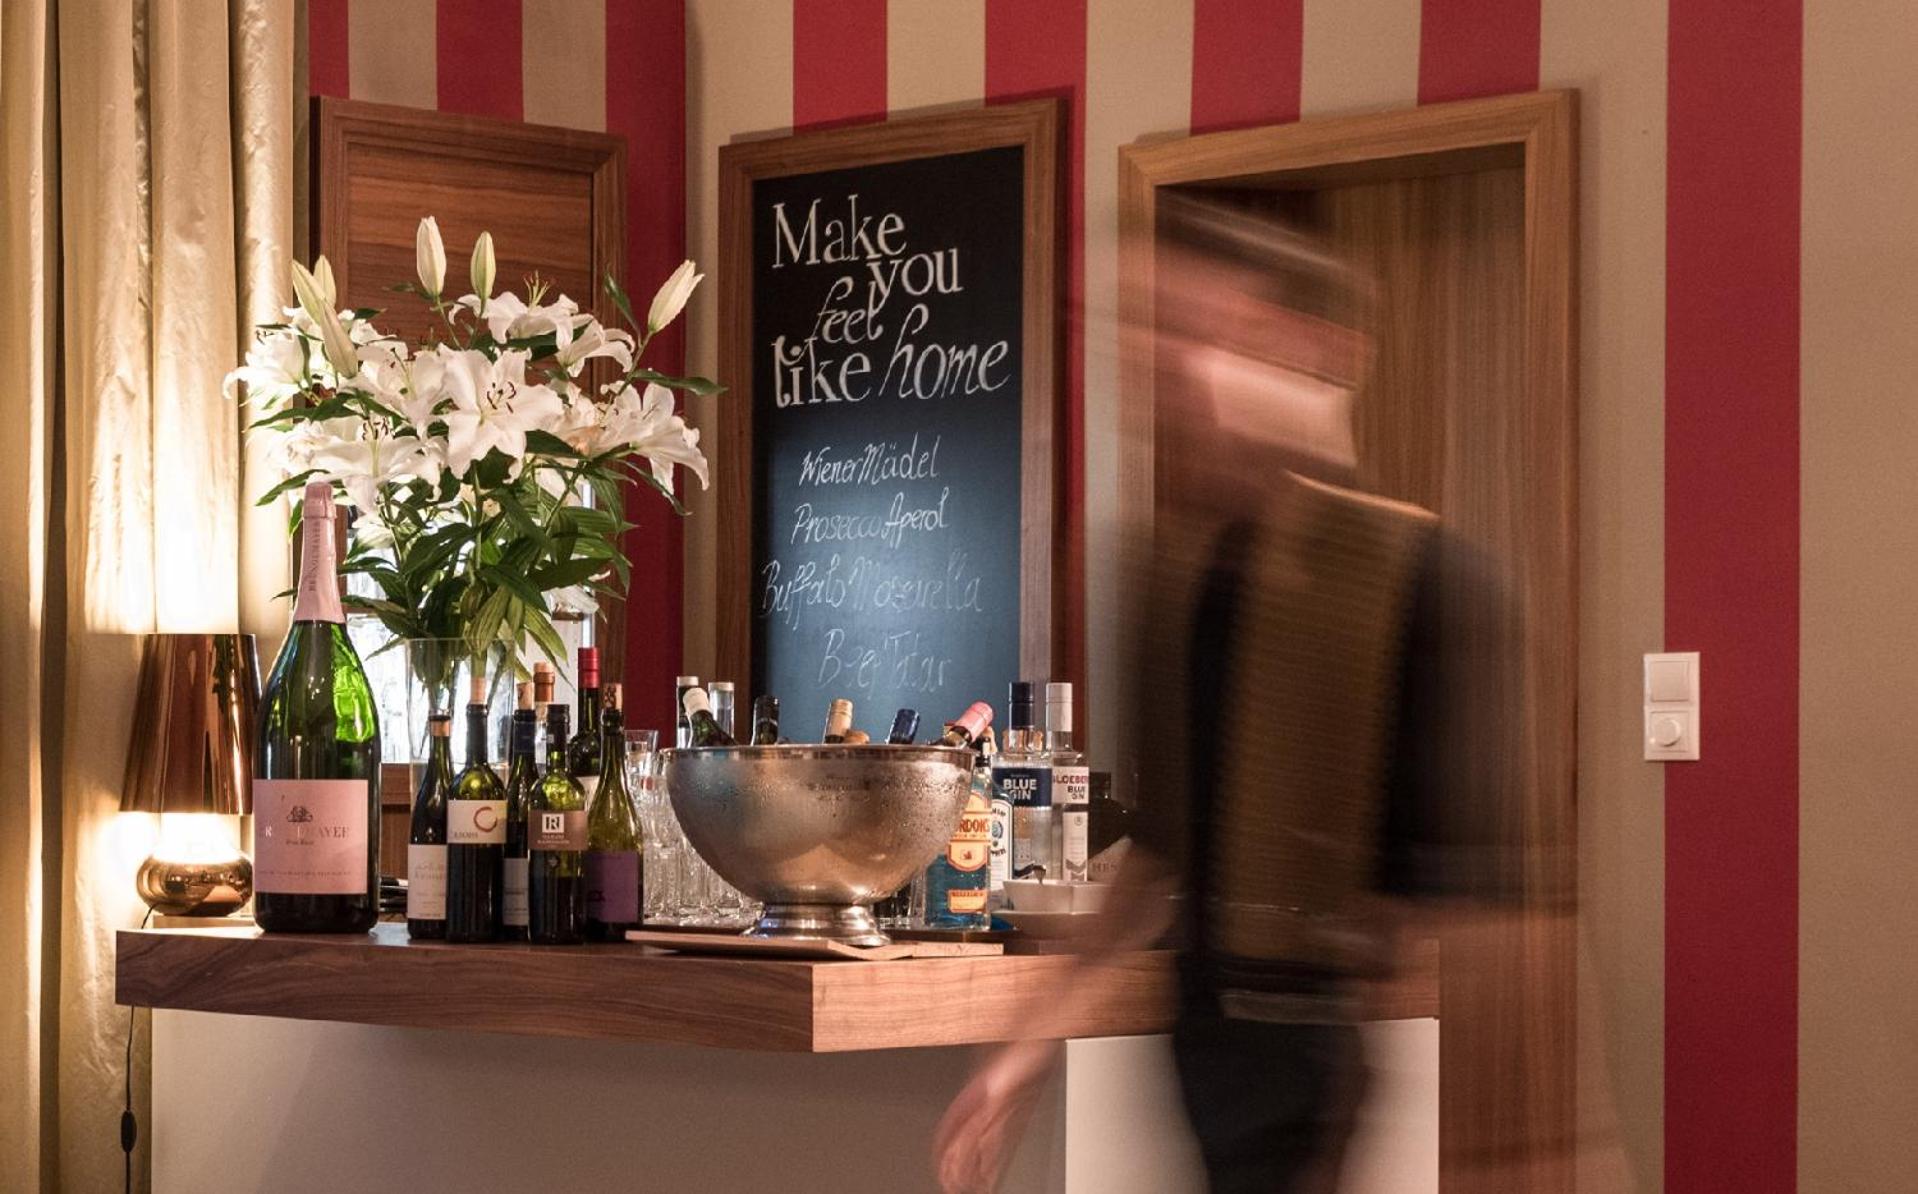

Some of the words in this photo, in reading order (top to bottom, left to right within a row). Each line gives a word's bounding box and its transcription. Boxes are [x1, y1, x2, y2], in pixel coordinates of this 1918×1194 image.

[772, 194, 907, 268] Make
[800, 275, 884, 348] feel
[866, 247, 965, 317] you
[878, 302, 1013, 399] home
[798, 446, 857, 487] Wiener
[857, 431, 941, 485] Mädel
[790, 502, 880, 545] Prosecco
[880, 486, 950, 550] Aperol
[1002, 778, 1037, 790] BLUE
[1008, 789, 1032, 800] GIN
